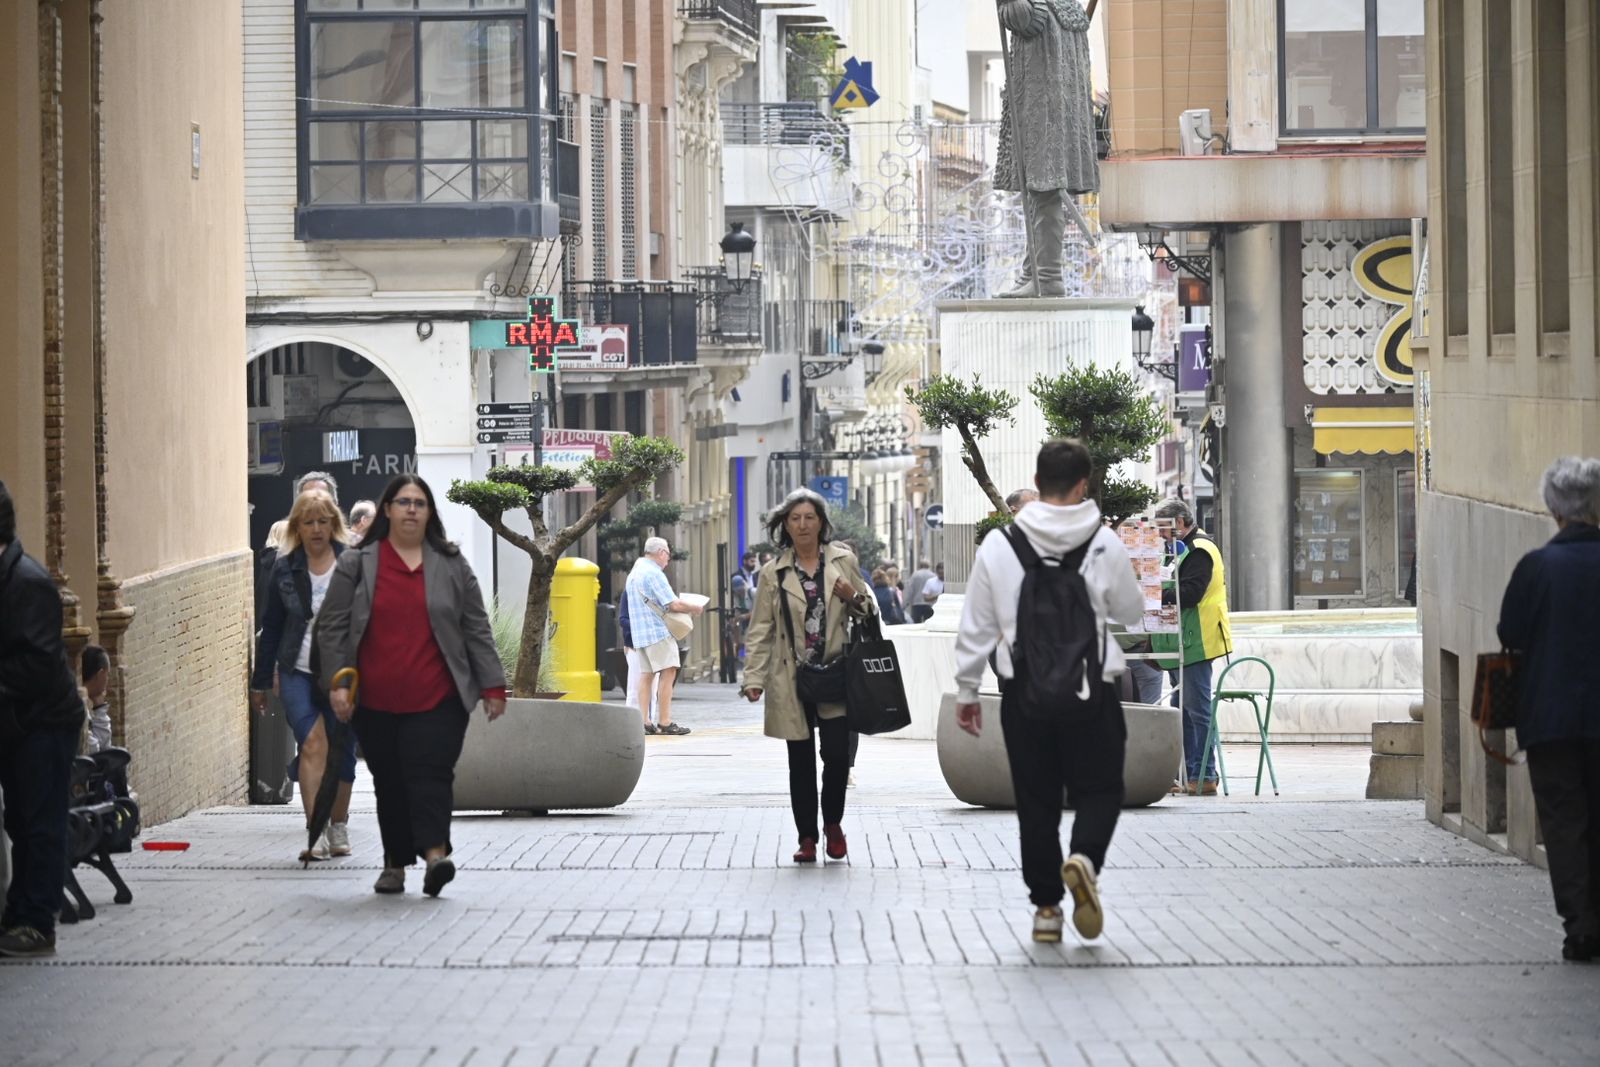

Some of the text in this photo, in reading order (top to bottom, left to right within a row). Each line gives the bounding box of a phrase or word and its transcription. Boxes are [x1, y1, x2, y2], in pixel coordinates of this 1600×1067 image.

[510, 322, 577, 344] RMA
[602, 352, 625, 362] CGT
[329, 430, 360, 462] FARMACIA
